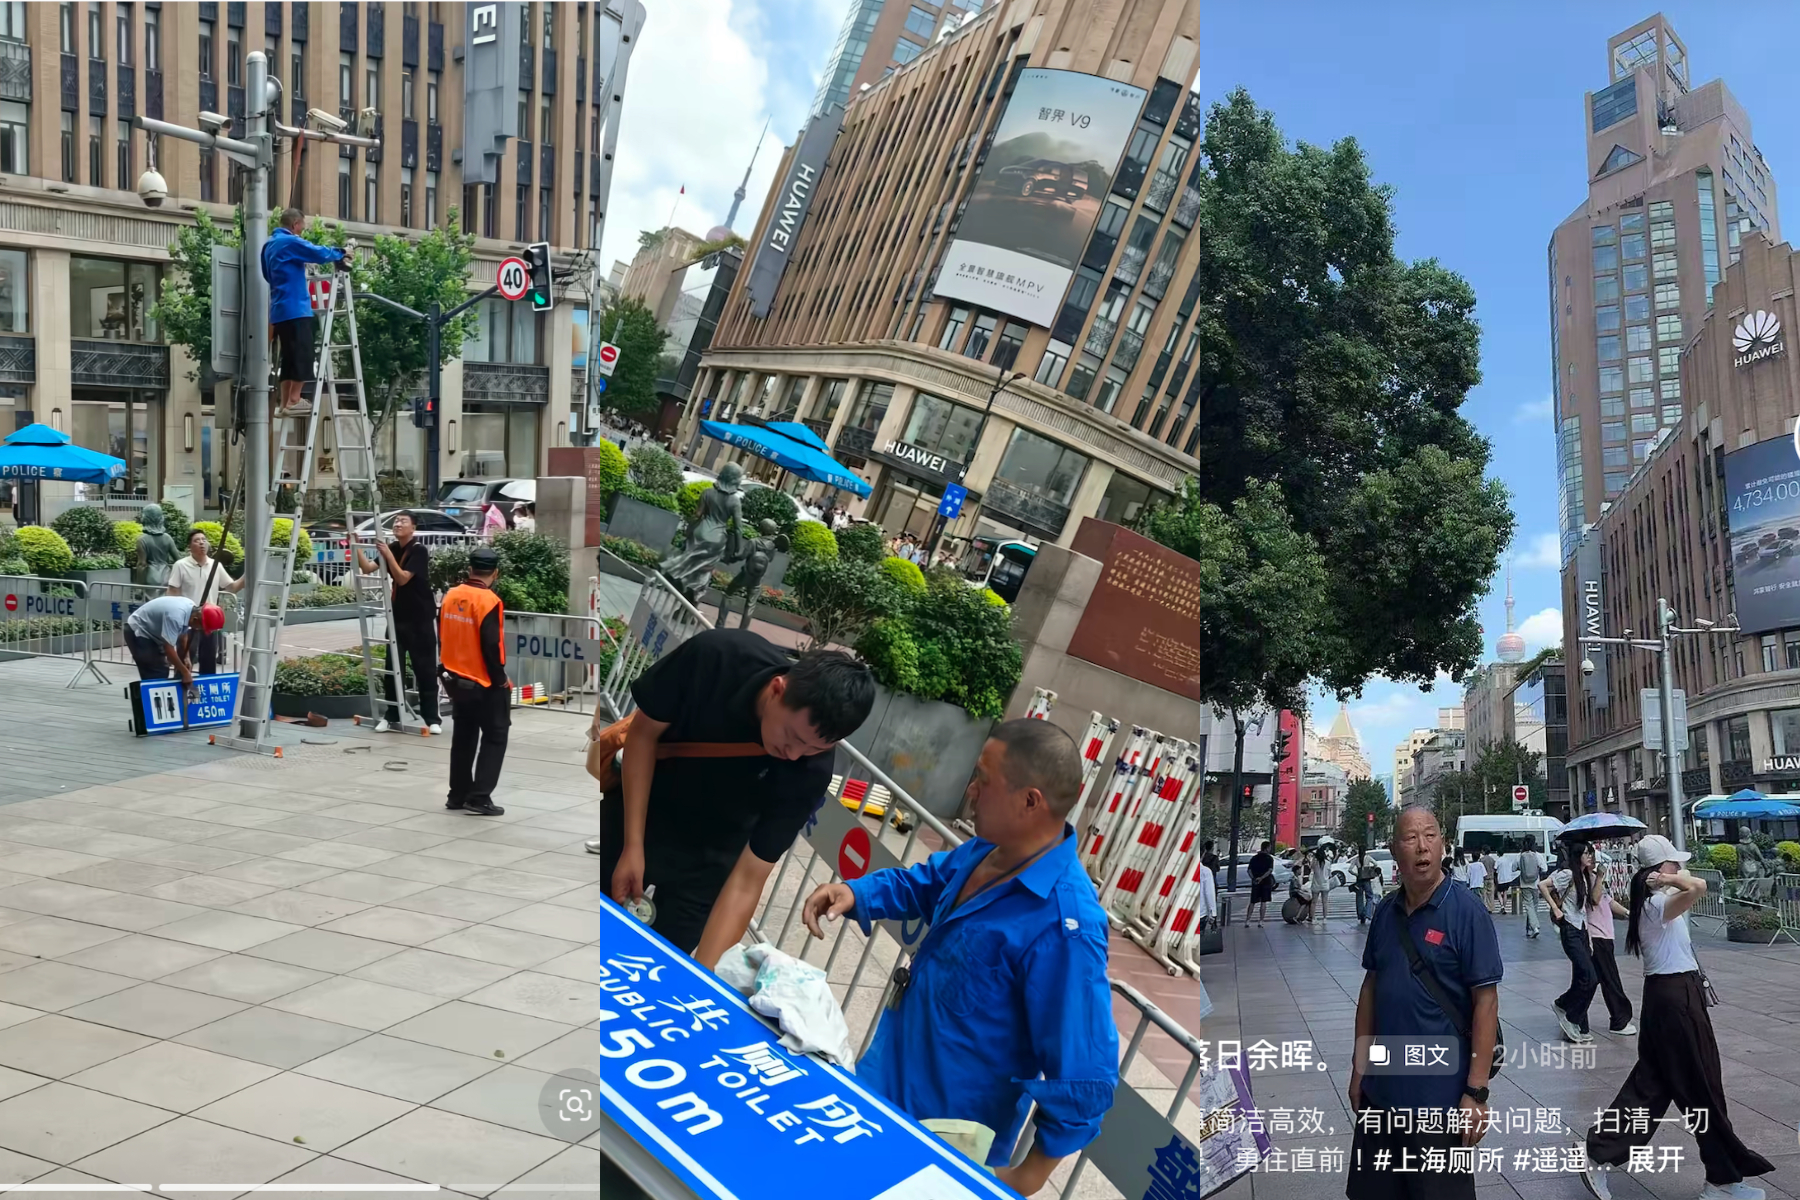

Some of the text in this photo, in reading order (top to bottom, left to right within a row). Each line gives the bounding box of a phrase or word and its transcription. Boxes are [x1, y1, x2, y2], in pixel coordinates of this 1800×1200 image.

[1038, 106, 1091, 129] 智界 V9
[770, 163, 815, 252] HUAWEI
[503, 267, 523, 289] 40
[1734, 342, 1784, 367] HUAWEI
[735, 435, 767, 456] POLICE
[884, 439, 947, 473] HUAWEI
[2, 465, 46, 477] POLICE
[26, 596, 75, 616] POLICE
[517, 635, 584, 660] POLICE
[211, 695, 230, 703] TOILET
[197, 705, 226, 718] 450m
[607, 952, 883, 1144] 公共厕所
[699, 1055, 825, 1145] TOILET
